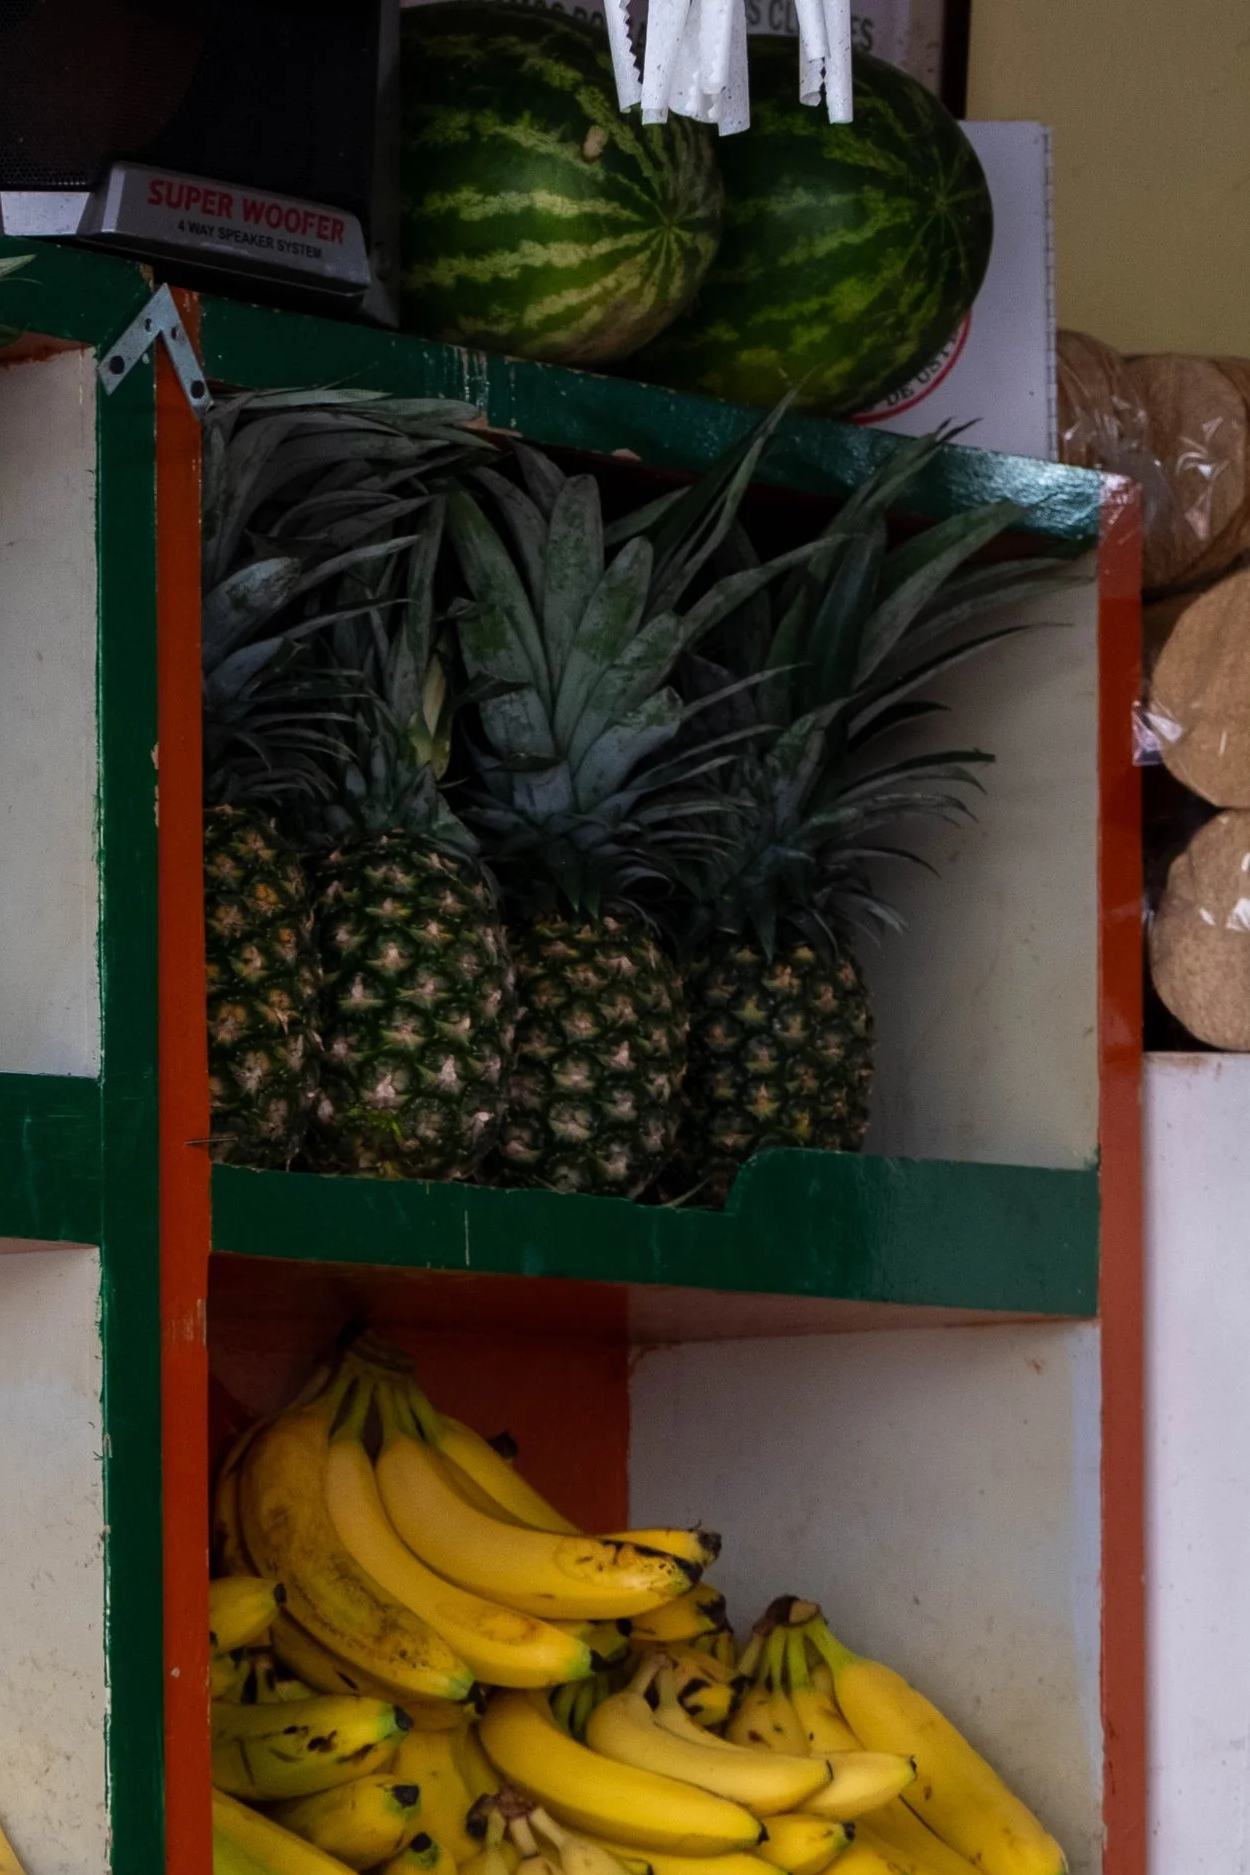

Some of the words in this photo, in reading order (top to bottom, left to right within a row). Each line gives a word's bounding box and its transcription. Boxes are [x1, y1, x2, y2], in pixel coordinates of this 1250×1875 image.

[147, 178, 234, 219] SUPER
[241, 197, 345, 244] WOOFER
[177, 220, 185, 232] 4
[186, 220, 215, 238] WAY
[217, 228, 274, 250] SPEAKER
[276, 238, 322, 259] SYSTEM
